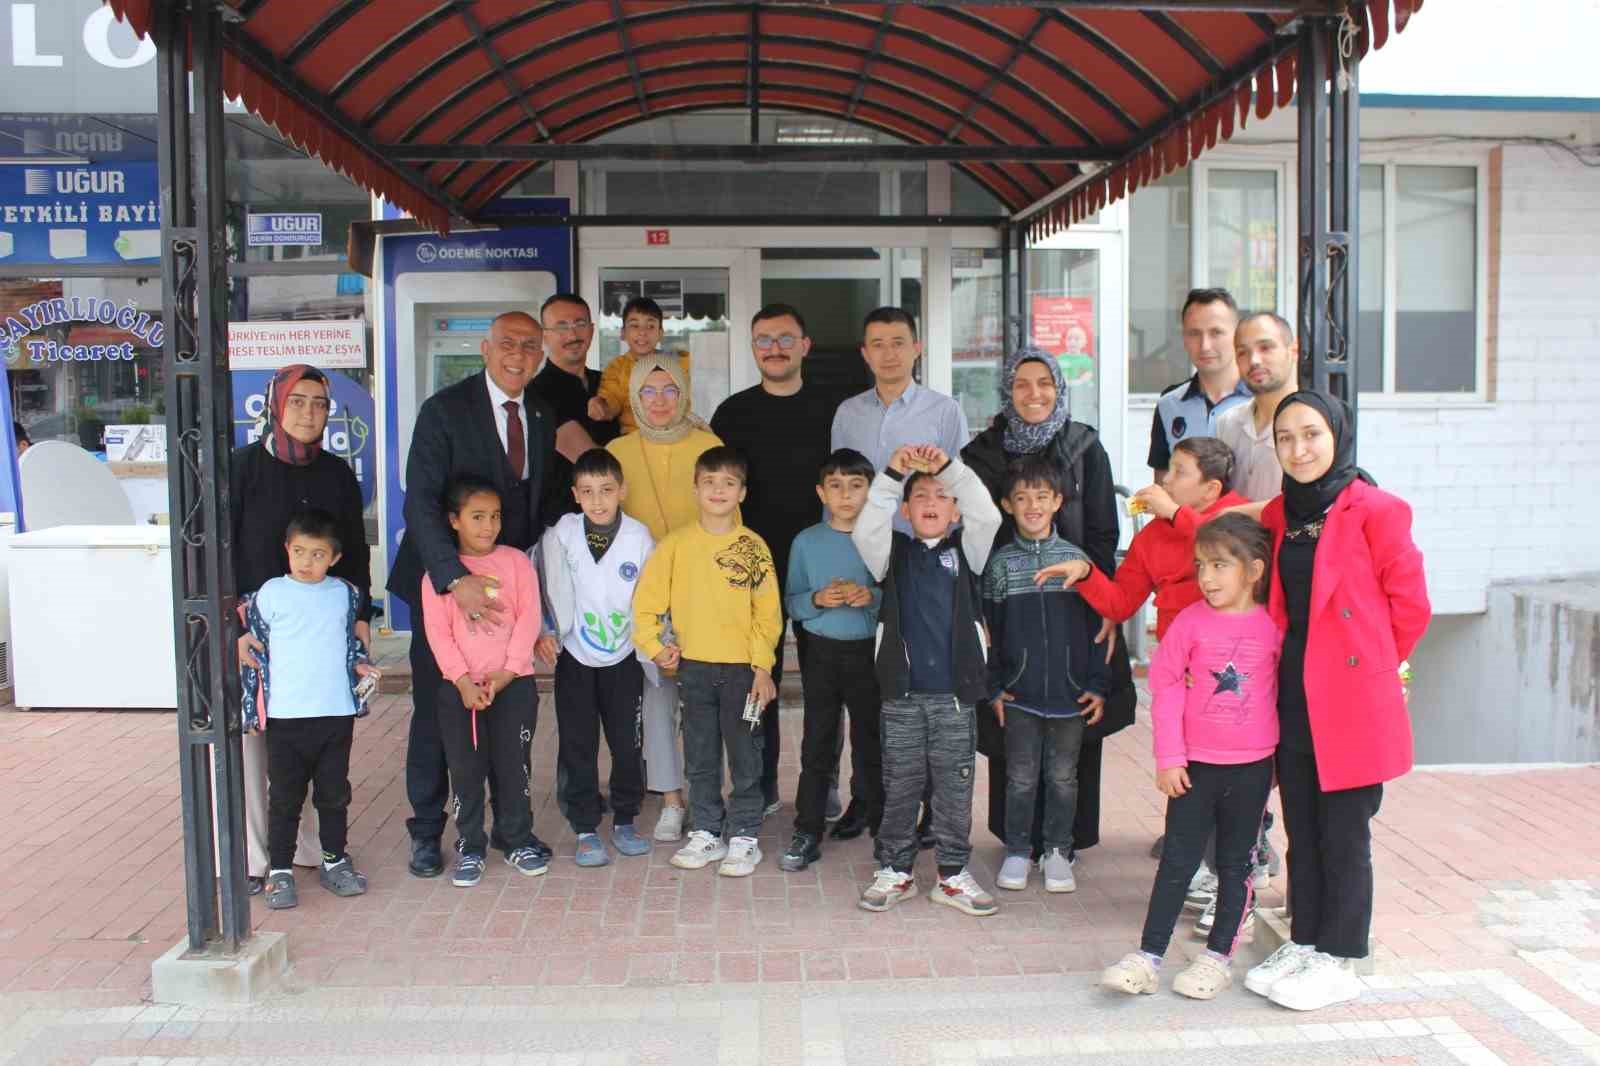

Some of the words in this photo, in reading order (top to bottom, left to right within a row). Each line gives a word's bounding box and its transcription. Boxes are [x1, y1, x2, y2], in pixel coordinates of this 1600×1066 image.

[56, 168, 125, 194] UĞUR
[0, 202, 88, 223] ETKİLİ
[98, 201, 160, 223] BAYİ
[650, 232, 667, 243] 12
[485, 247, 538, 259] NOKTASI
[289, 329, 311, 341] HER
[312, 328, 352, 340] YERİNE
[27, 340, 135, 361] Ticaret
[257, 345, 296, 357] TESLİM
[298, 345, 332, 355] BEYAZ
[335, 343, 361, 356] EŞYA
